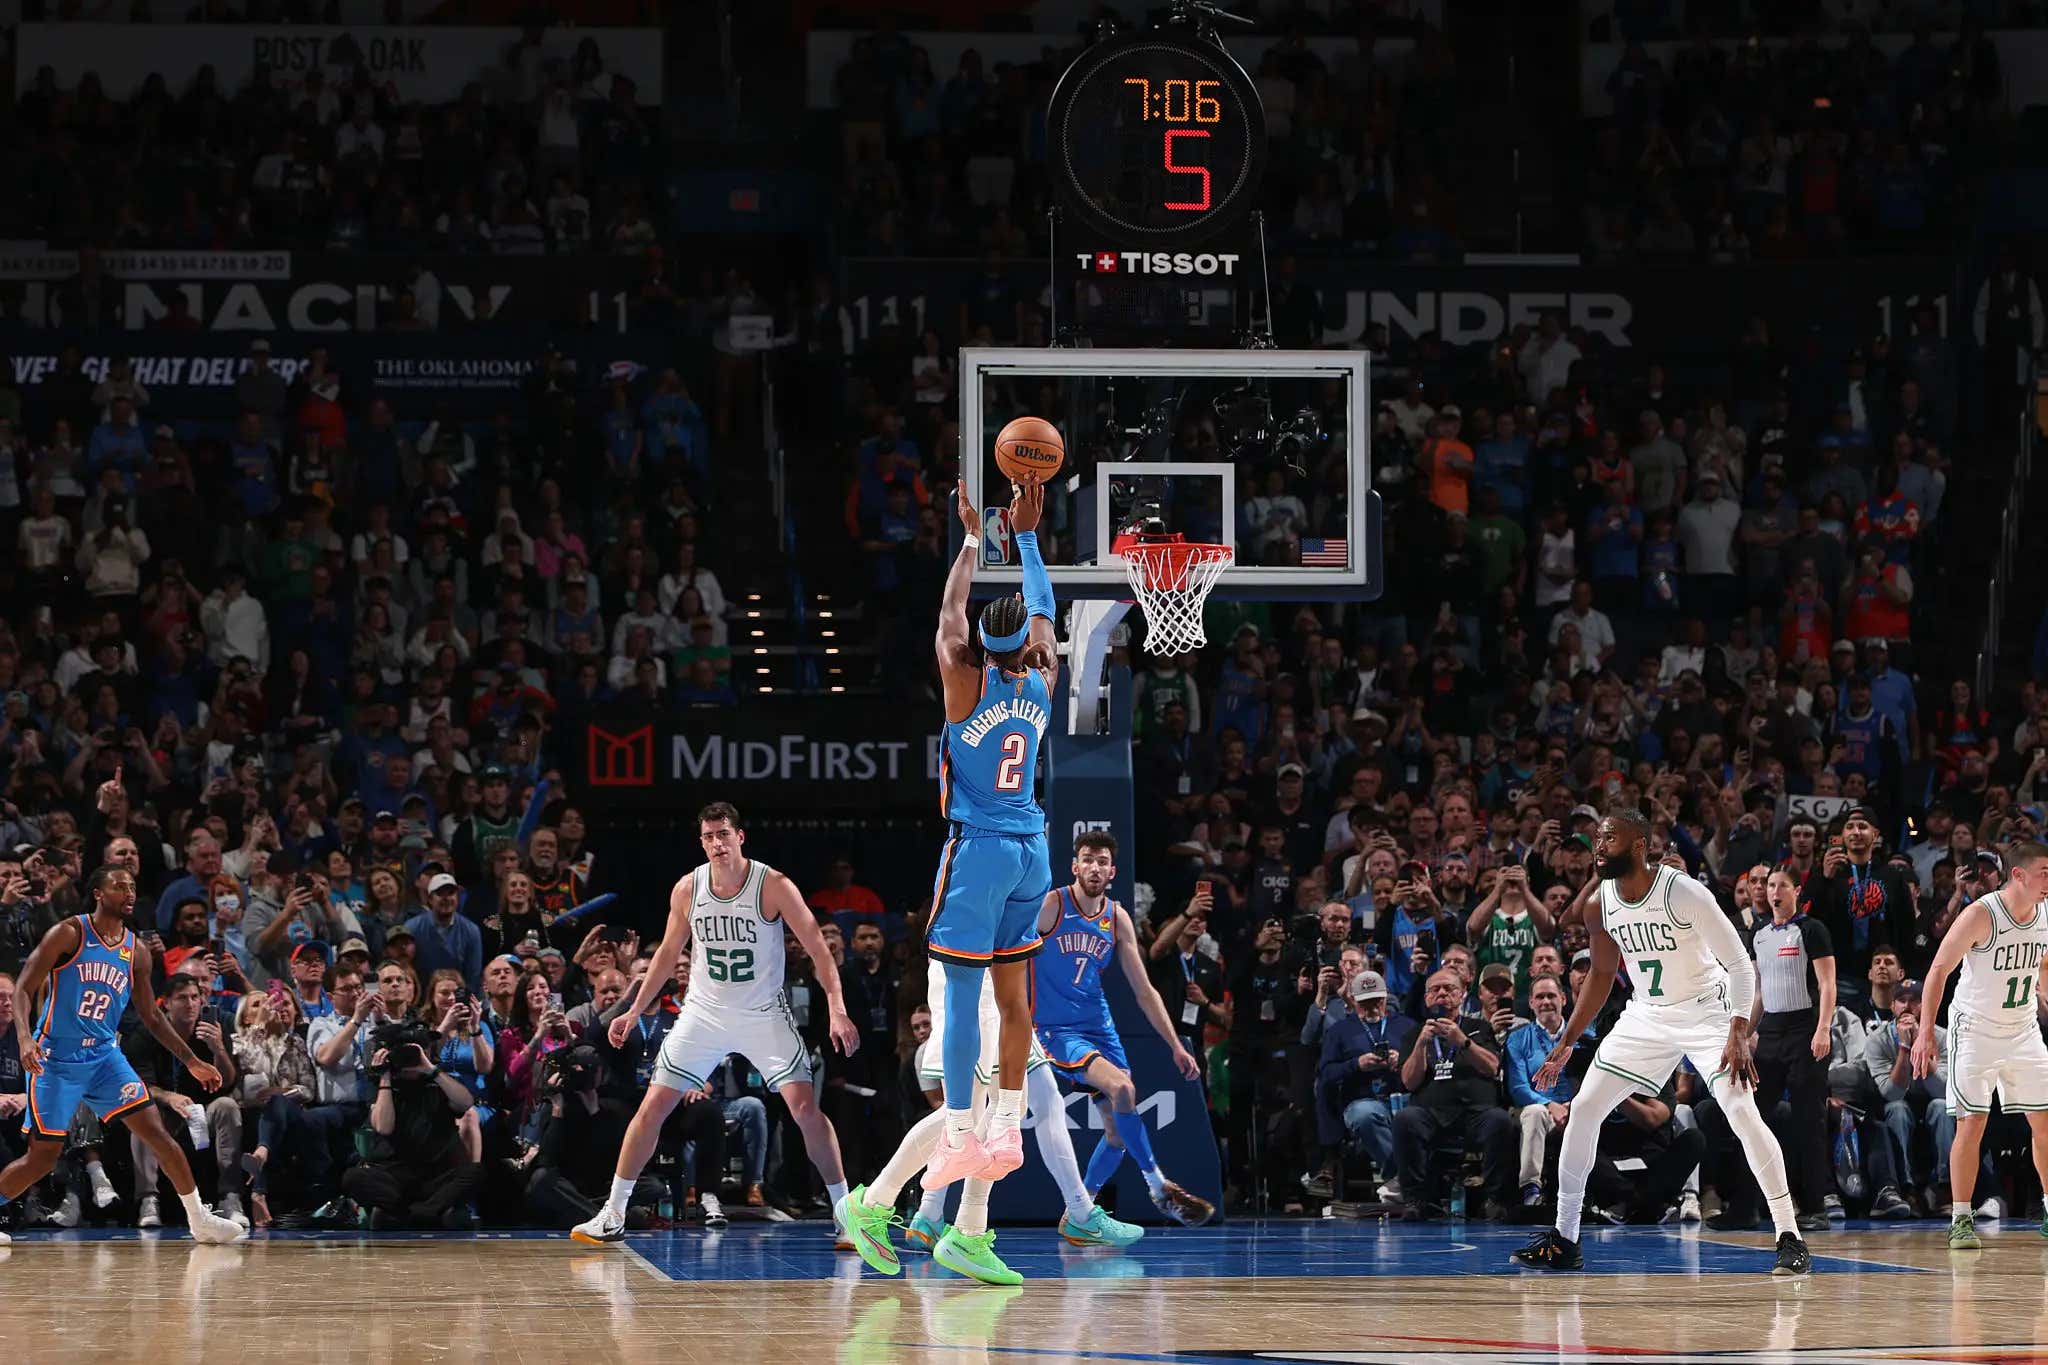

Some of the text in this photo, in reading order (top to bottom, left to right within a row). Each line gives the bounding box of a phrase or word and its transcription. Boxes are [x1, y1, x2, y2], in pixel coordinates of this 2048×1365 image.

[255, 37, 426, 72] POST OAK
[1124, 78, 1221, 123] 7:06
[1164, 129, 1212, 210] 5
[263, 256, 285, 271] 20
[1076, 252, 1240, 275] T TISSOT
[128, 357, 187, 385] HAT
[188, 357, 310, 386] DELIR
[375, 359, 416, 377] THE
[1015, 445, 1057, 463] Wilson
[960, 697, 1048, 748] GILGEOUS-ALEXAN
[996, 731, 1027, 792] 2
[695, 915, 757, 943] CELTICS
[1491, 928, 1535, 947] BOSTON
[1610, 922, 1678, 953] CELTICS
[1056, 932, 1112, 959] THUNDER
[76, 961, 129, 994] THUNDER
[706, 946, 755, 982] 52
[1074, 957, 1089, 984] 7
[1505, 949, 1523, 975] 7
[1638, 959, 1665, 996] 7
[78, 989, 112, 1021] 22
[2001, 974, 2033, 1009] 11
